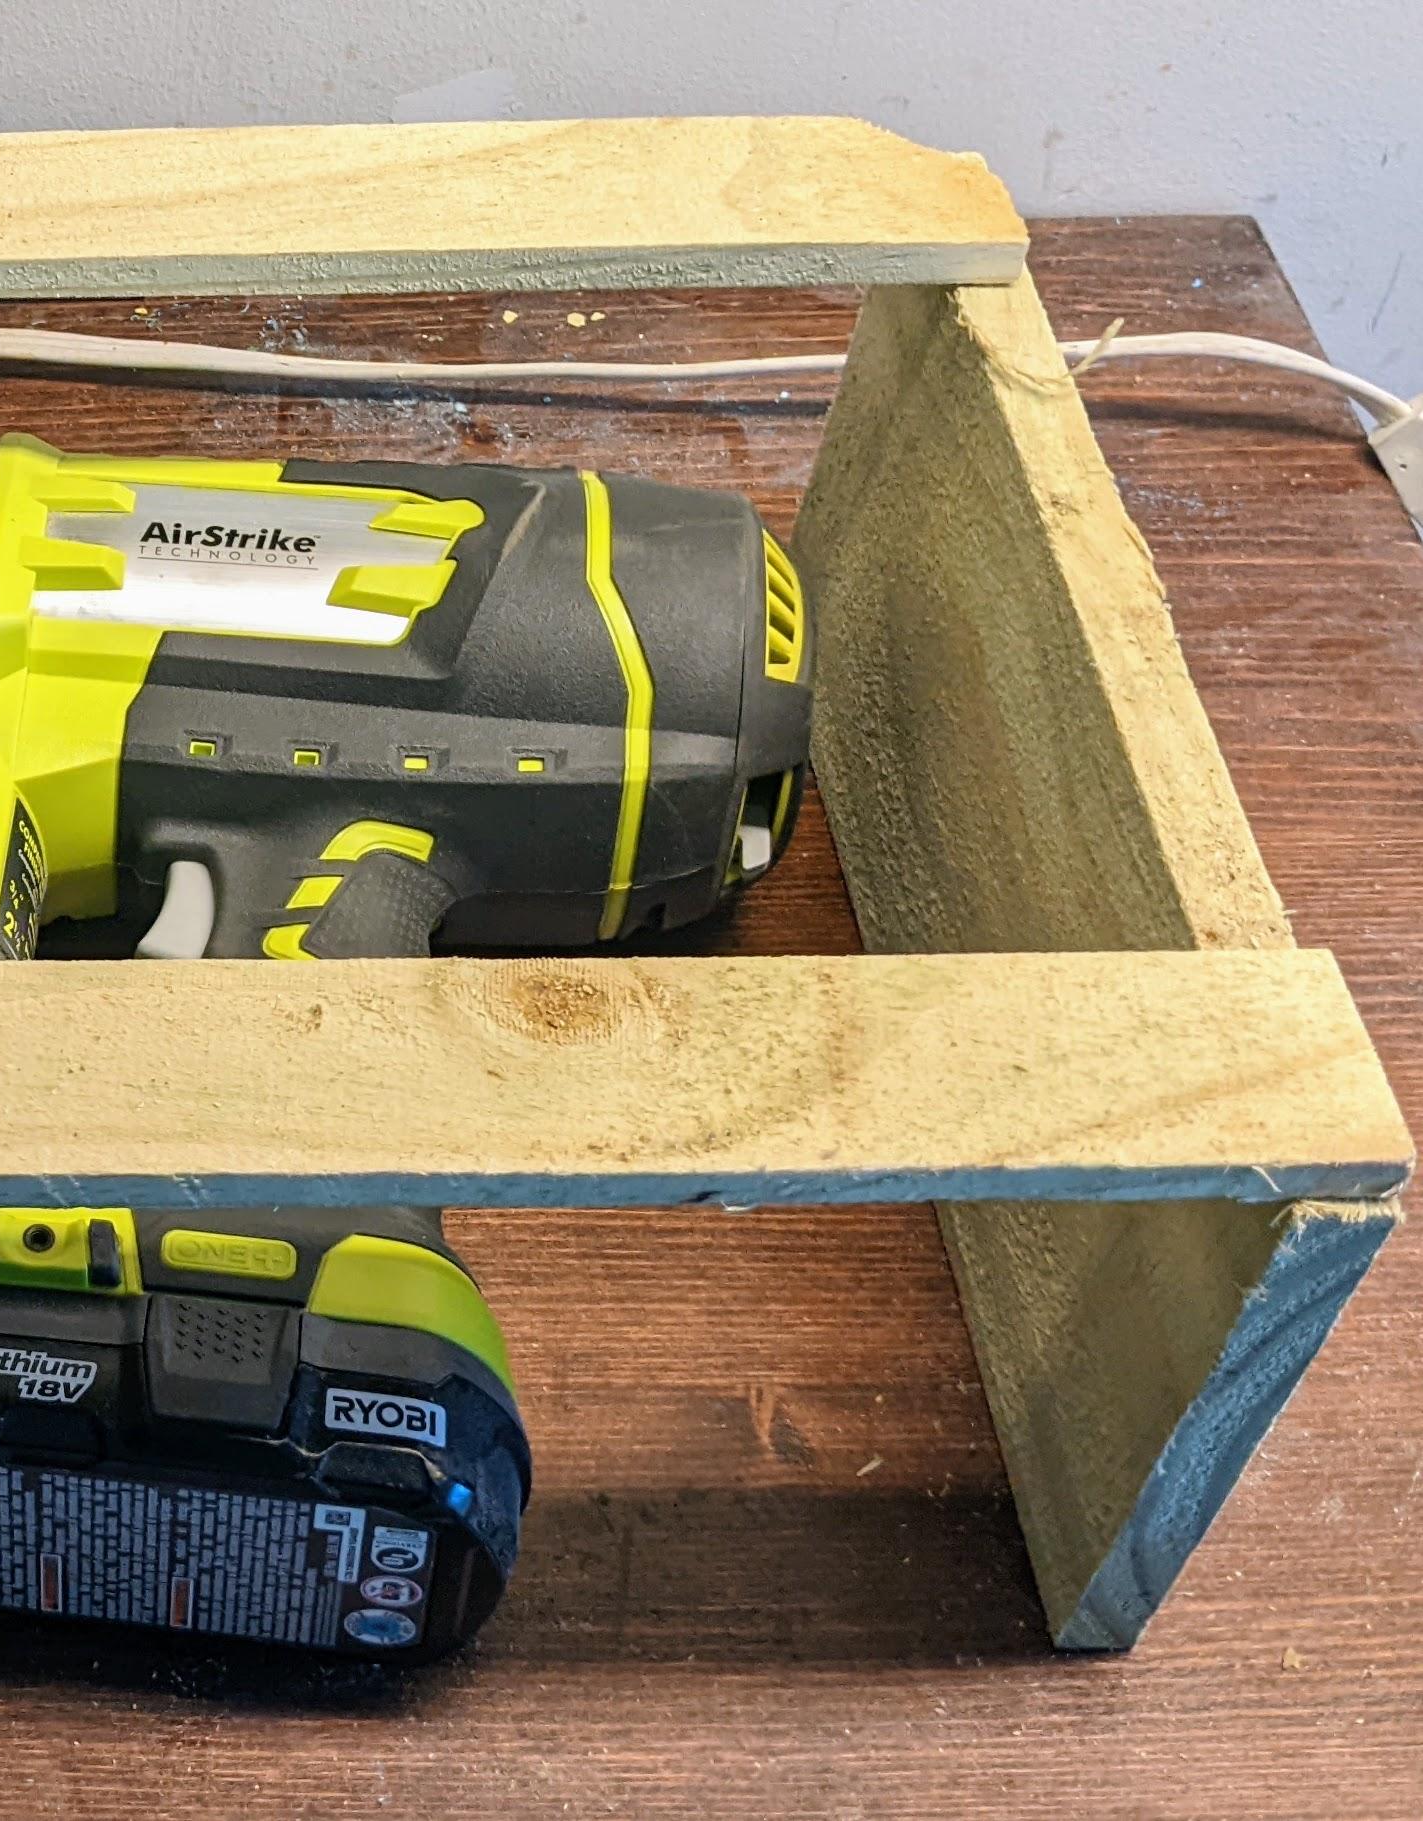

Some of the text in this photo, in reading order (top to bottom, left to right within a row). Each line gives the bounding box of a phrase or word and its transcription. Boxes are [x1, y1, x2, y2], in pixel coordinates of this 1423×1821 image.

[138, 545, 315, 565] TECHNOLOGY
[22, 1378, 87, 1401] 18V
[332, 1395, 436, 1437] RYOBI
